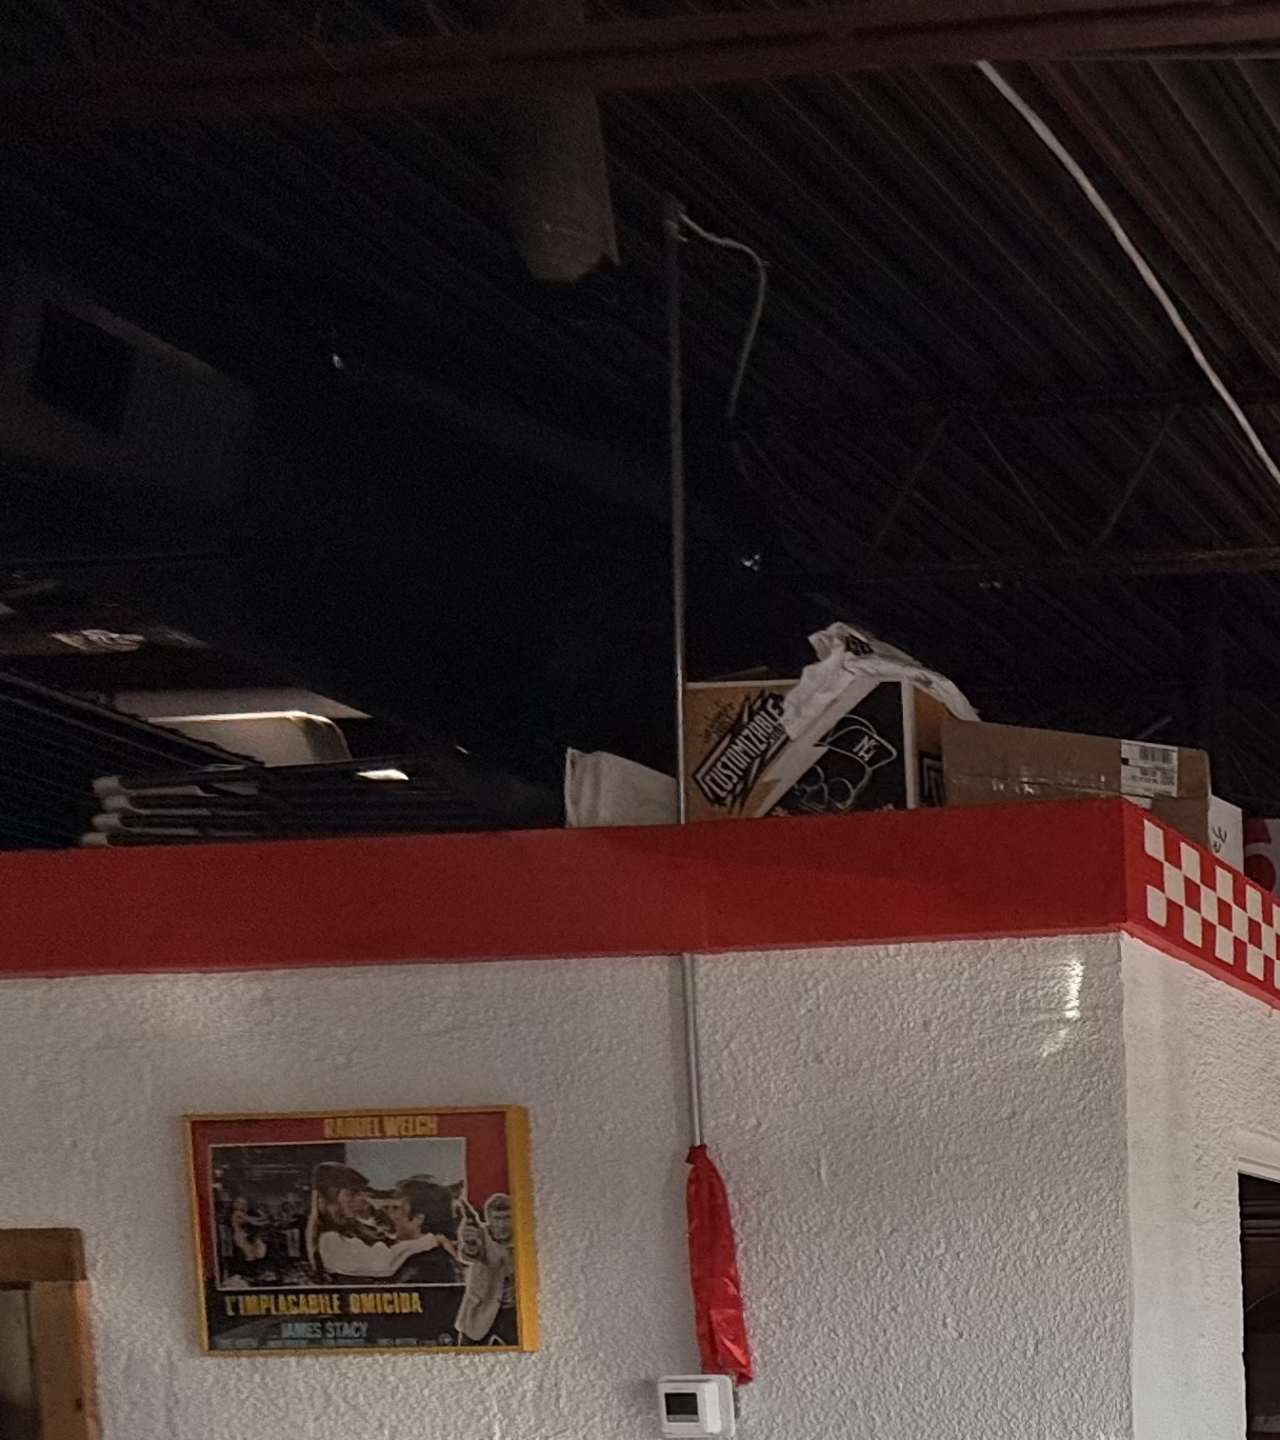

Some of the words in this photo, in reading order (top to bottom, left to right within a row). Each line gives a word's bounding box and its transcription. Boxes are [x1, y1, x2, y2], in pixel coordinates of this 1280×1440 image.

[382, 1115, 438, 1137] WELCH
[350, 1292, 423, 1314] OMICIDA
[325, 1321, 369, 1338] STACY
